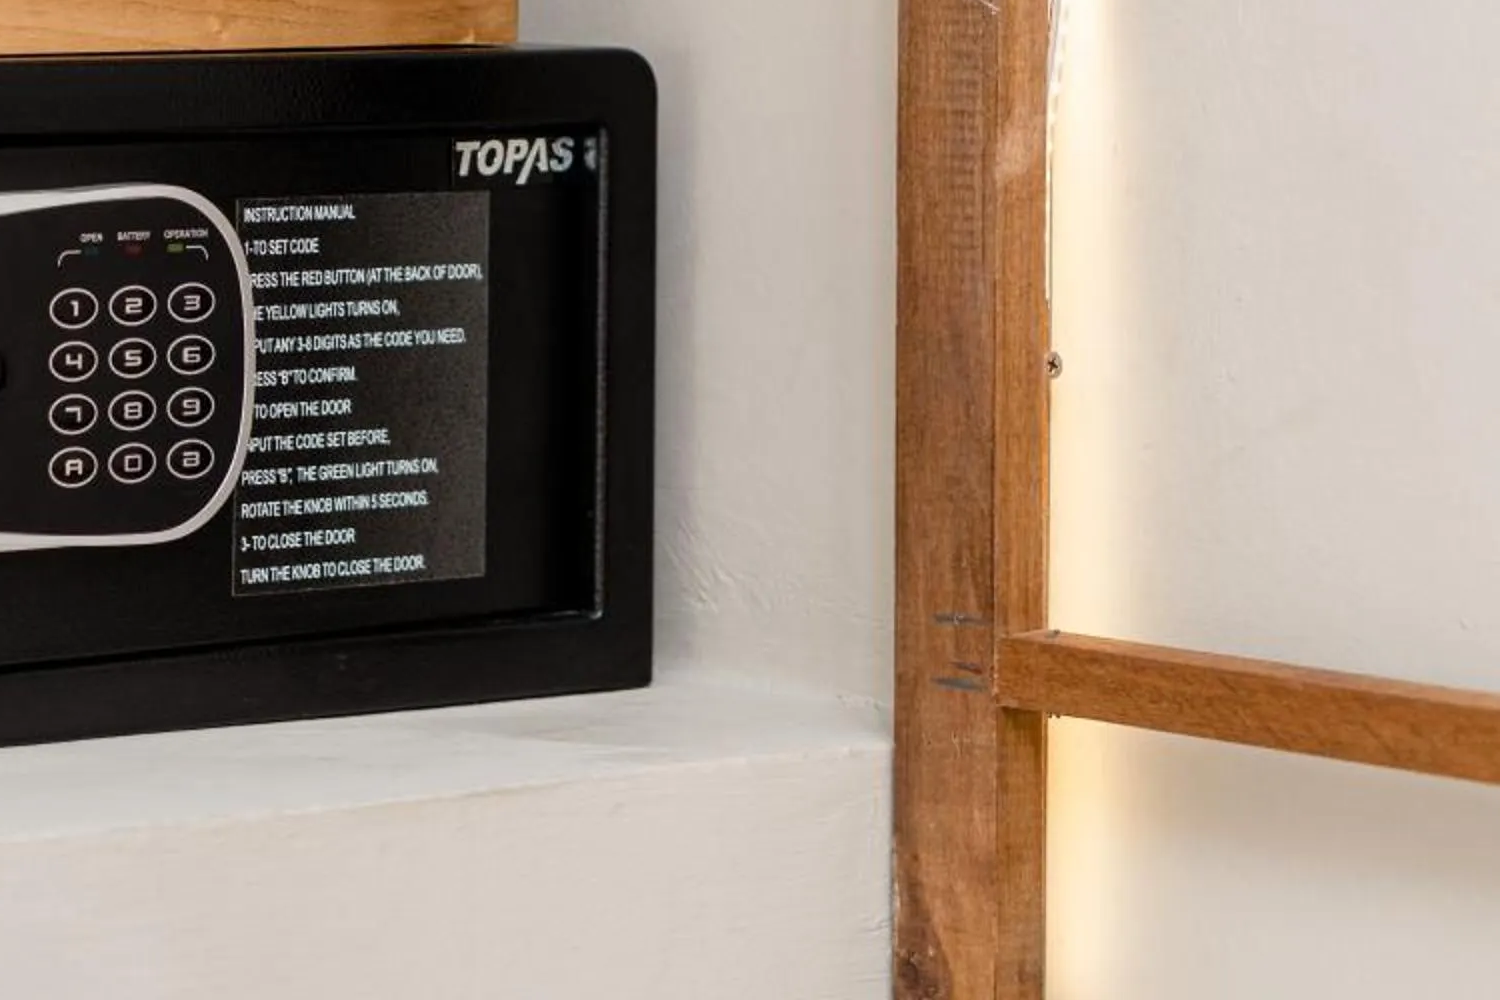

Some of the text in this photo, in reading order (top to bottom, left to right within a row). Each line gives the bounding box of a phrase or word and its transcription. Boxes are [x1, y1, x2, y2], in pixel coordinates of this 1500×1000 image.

[455, 136, 575, 185] TOPAS
[243, 204, 356, 223] INSTRUCTION MANUAL
[269, 239, 288, 255] SET
[289, 238, 320, 254] CODE
[250, 273, 278, 289] RESS
[280, 272, 300, 287] THE
[301, 270, 323, 286] RED
[323, 269, 365, 286] BUTTON
[383, 267, 402, 284] THE
[403, 266, 432, 282] BACK
[433, 265, 446, 281] OF
[69, 300, 80, 317] 1
[124, 297, 143, 315] 2
[183, 295, 201, 311] 3
[265, 304, 308, 321] YELLOW
[309, 303, 345, 319] LIGHTS
[346, 300, 380, 317] TURNS
[254, 338, 273, 354] PUT
[274, 337, 296, 353] ANY
[314, 334, 346, 351] DIGITS
[347, 334, 362, 349] AS
[363, 332, 383, 348] THE
[384, 331, 413, 347] CODE
[414, 330, 436, 345] YOU
[65, 352, 83, 370] 4
[124, 350, 143, 367] 5
[182, 347, 201, 363] 6
[254, 372, 277, 387] ESS
[293, 369, 307, 385] TO
[64, 406, 82, 423] 7
[123, 402, 143, 420] 8
[183, 399, 200, 416] 9
[255, 400, 352, 420] TO OPEN THE DOOR
[274, 435, 294, 451] THE
[295, 433, 325, 449] CODE
[326, 432, 347, 448] SET
[64, 458, 83, 477] A
[241, 470, 276, 487] PRESS
[296, 466, 317, 483] THE
[318, 464, 354, 480] GREEN
[355, 462, 384, 478] LIGHT
[385, 459, 420, 476] TURNS
[241, 502, 281, 519] ROTATE
[282, 500, 303, 516] THE
[304, 498, 332, 514] KNOB
[334, 496, 370, 511] WITHIN
[252, 536, 266, 551] TO
[267, 532, 303, 549] CLOSE
[304, 531, 324, 547] THE
[325, 528, 356, 545] DOOR
[240, 568, 269, 585] TURN
[270, 566, 291, 581] THE
[291, 564, 321, 580] KNOB
[322, 562, 336, 577] TO
[337, 560, 371, 576] CLOSE
[373, 558, 393, 574] THE
